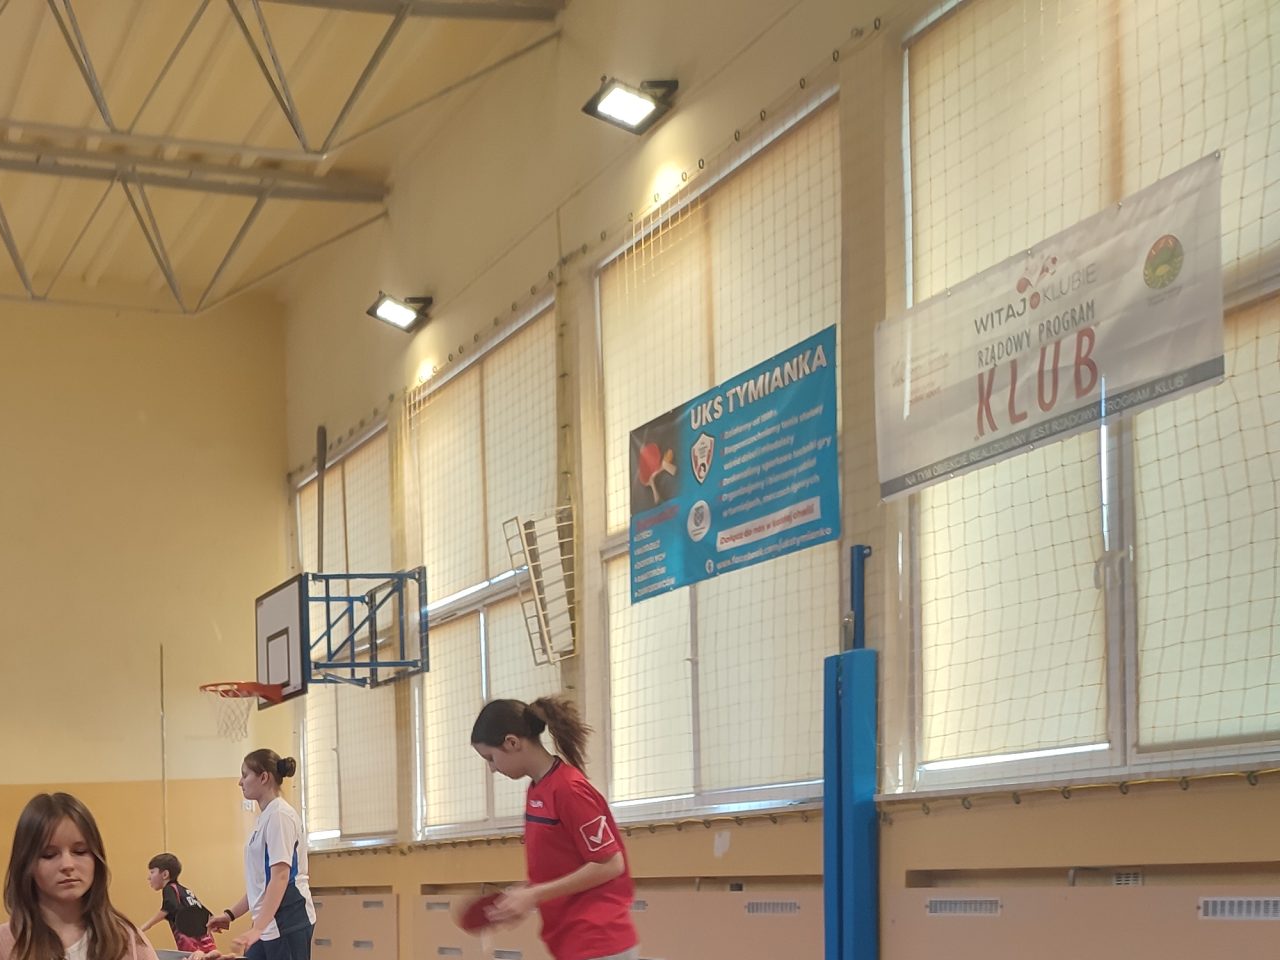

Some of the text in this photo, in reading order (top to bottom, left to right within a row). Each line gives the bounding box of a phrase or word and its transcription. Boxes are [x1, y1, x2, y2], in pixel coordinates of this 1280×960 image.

[974, 262, 1097, 335] WITAJ KLUBIE
[977, 299, 1096, 369] RZĄDOWY PROGRAM
[689, 395, 724, 431] UKS
[726, 344, 828, 413] TYMIANKA
